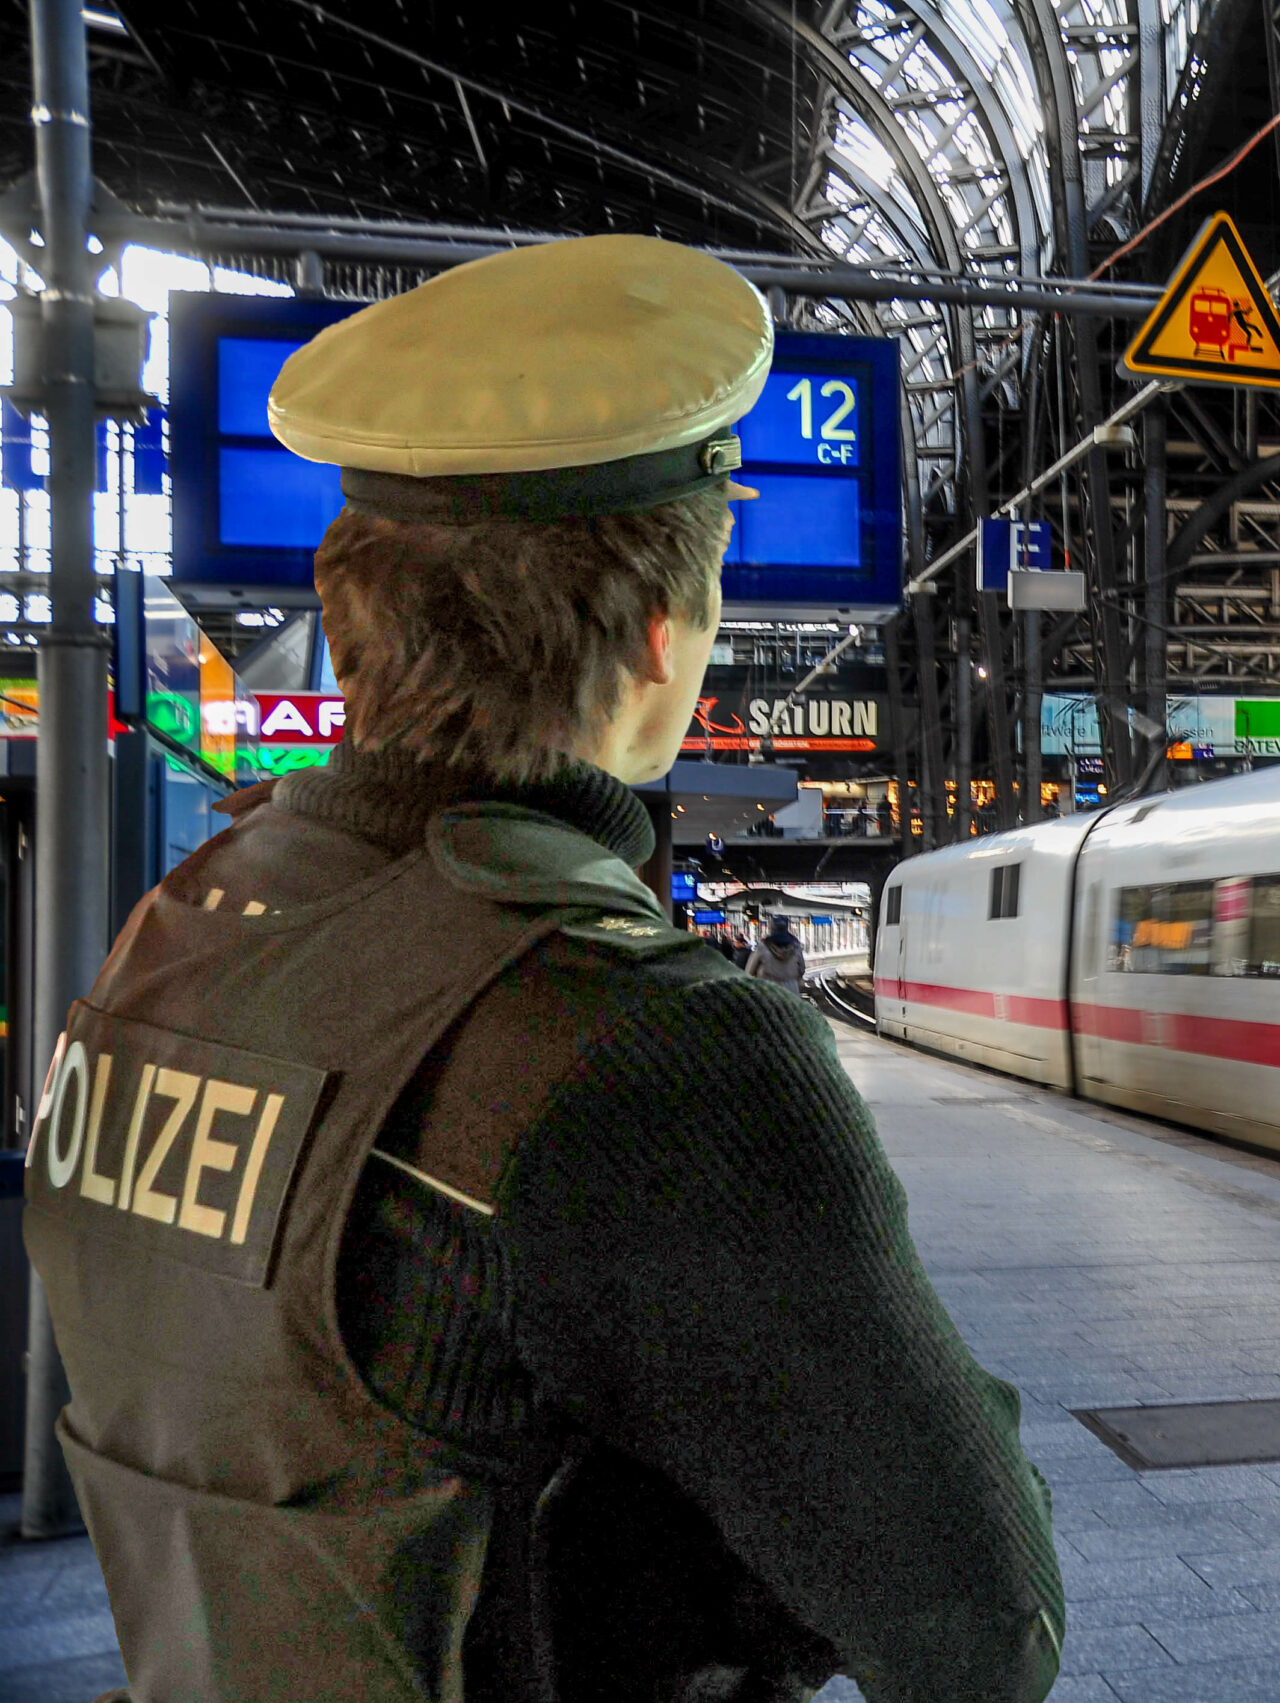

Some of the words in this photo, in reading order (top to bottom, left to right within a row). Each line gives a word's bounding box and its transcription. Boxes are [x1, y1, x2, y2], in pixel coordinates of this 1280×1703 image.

[786, 378, 856, 441] 12
[817, 442, 854, 465] C-F
[1009, 522, 1042, 572] E
[749, 698, 878, 736] SATURN
